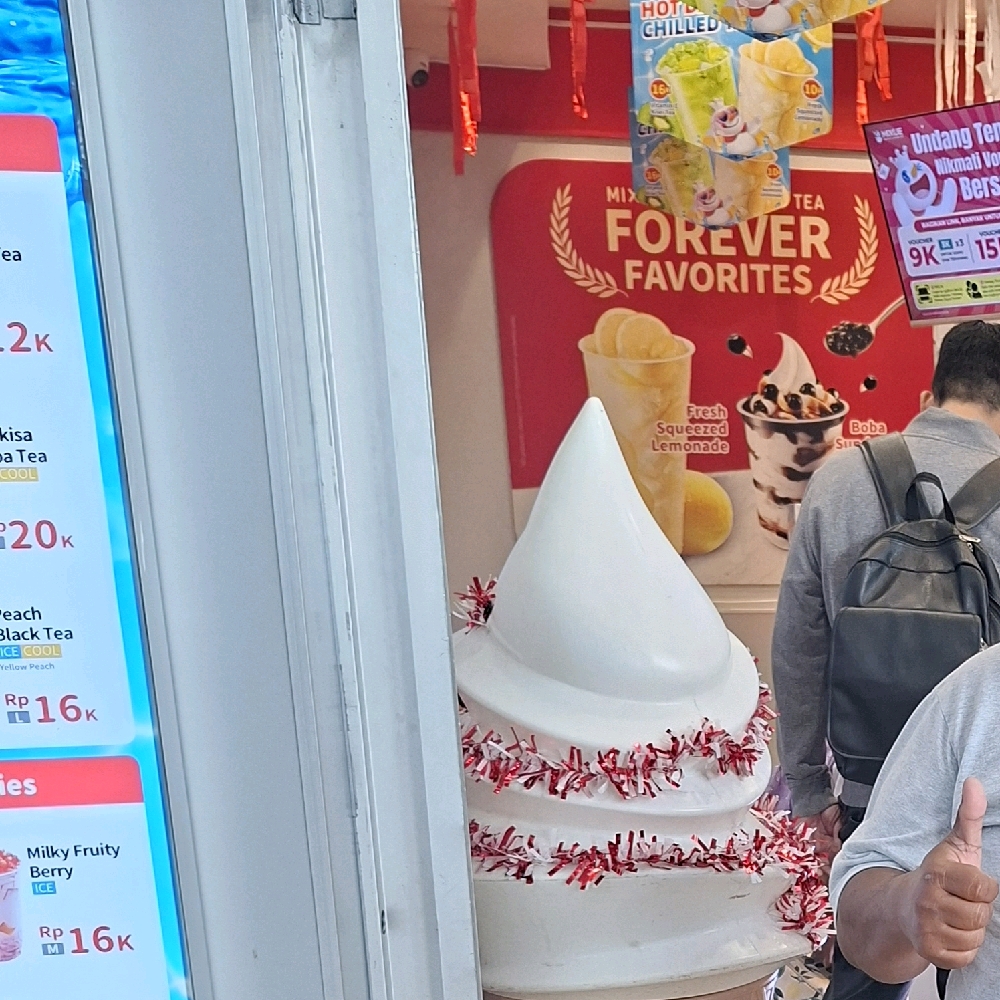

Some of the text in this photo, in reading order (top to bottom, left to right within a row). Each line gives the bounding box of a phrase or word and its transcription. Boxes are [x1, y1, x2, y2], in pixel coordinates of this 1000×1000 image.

[641, 0, 679, 18] HOT
[643, 17, 719, 37] CHILLED
[909, 127, 974, 155] Undang
[934, 153, 982, 175] Nikmati
[605, 186, 638, 203] MIX
[793, 193, 826, 211] TEA
[605, 208, 833, 259] FOREVER
[1, 250, 22, 262] ea
[909, 244, 941, 267] 9K
[623, 259, 814, 295] FAVORITES
[0, 322, 54, 353] 2K
[687, 405, 728, 419] Fresh
[0, 427, 33, 442] kisa
[656, 422, 729, 436] Squeezed
[851, 421, 885, 433] Boba
[651, 440, 730, 453] Lemonade
[16, 449, 48, 463] Tea
[0, 468, 36, 480] COOL
[0, 606, 42, 621] each
[0, 627, 73, 642] Black Tea
[0, 645, 61, 657] ICE COOL
[0, 663, 55, 672] Yellow Peach
[5, 693, 30, 709] Rp
[35, 694, 99, 723] 16K
[27, 843, 121, 862] Milky Fruity
[30, 866, 74, 880] Berry
[35, 883, 54, 894] ICE
[39, 926, 64, 940] Rp
[69, 926, 135, 955] 16K
